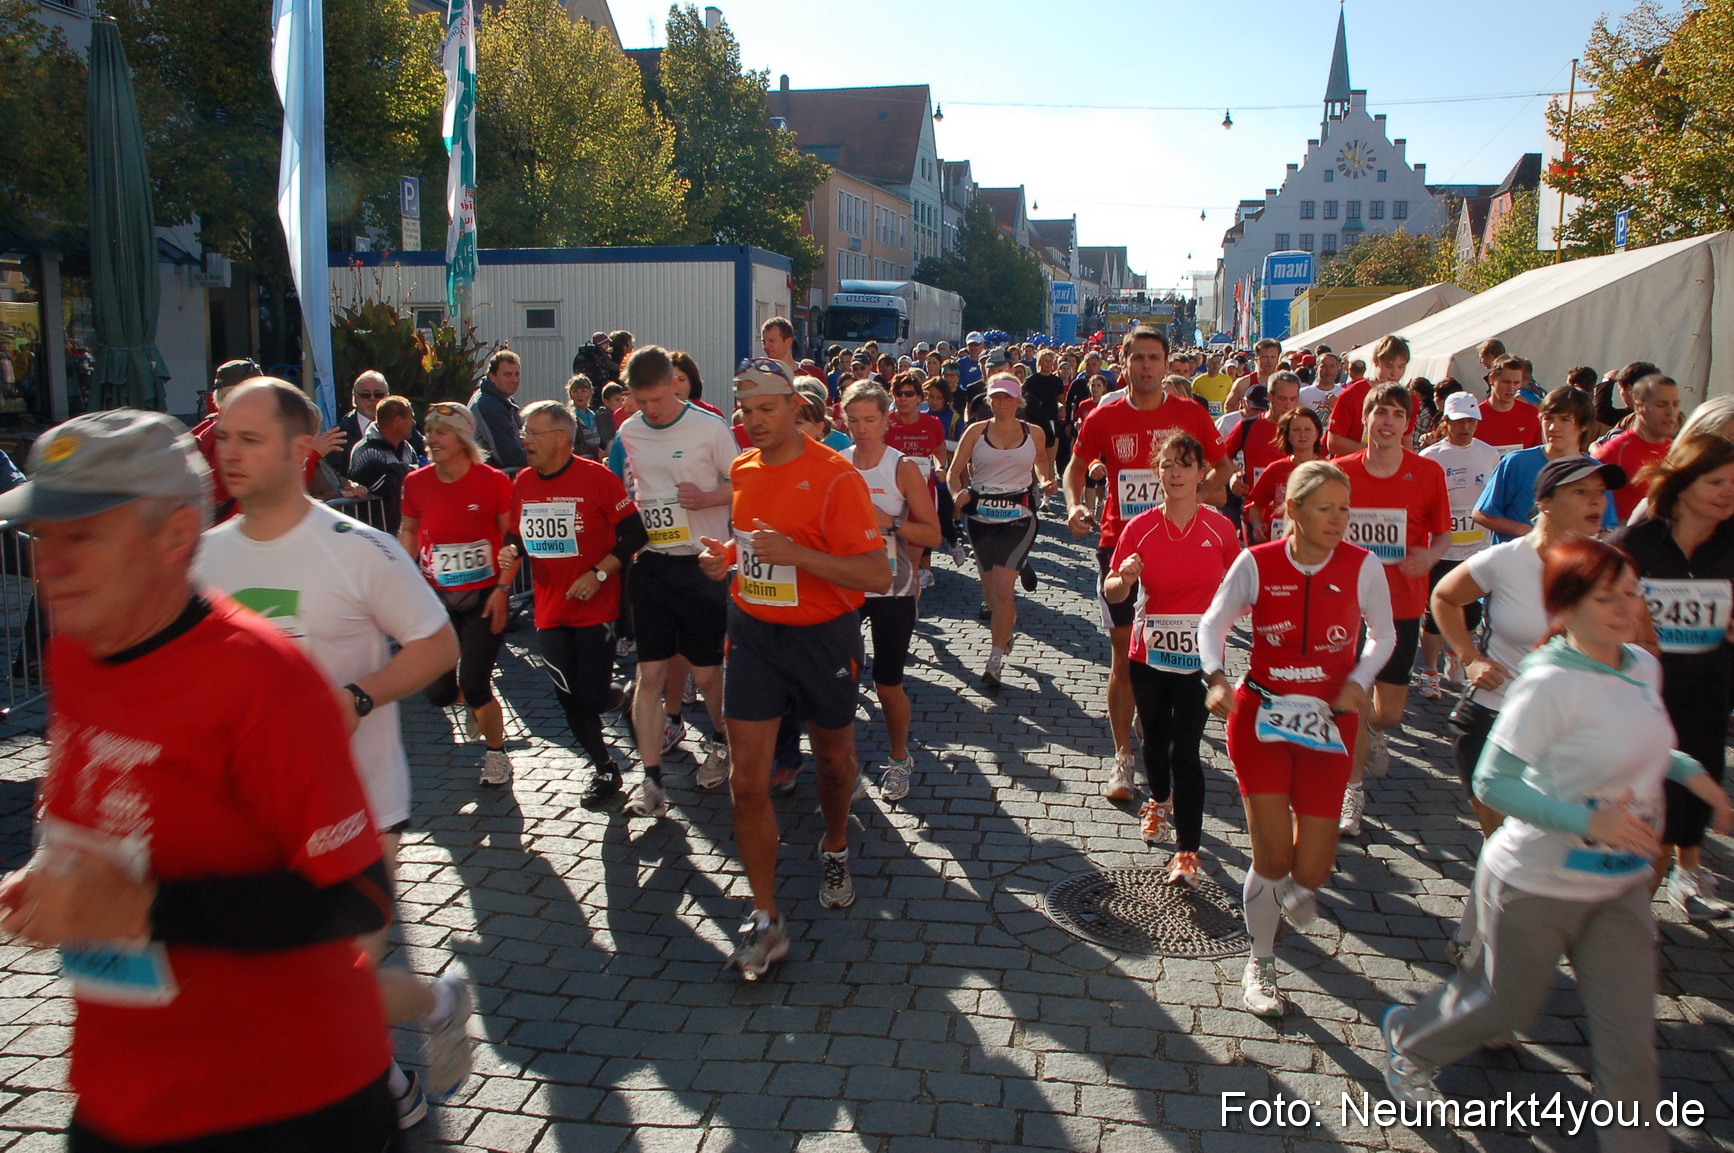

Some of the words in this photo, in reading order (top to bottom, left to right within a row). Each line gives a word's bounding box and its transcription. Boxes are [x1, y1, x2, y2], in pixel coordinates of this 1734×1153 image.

[404, 181, 415, 211] P
[1617, 216, 1625, 242] P
[1273, 260, 1309, 279] maxi
[1053, 288, 1072, 300] axi
[1059, 305, 1069, 313] dsl
[1126, 482, 1165, 502] 247
[643, 507, 674, 529] 833
[986, 509, 1012, 518] Sabine
[526, 518, 568, 539] 3305
[1349, 523, 1399, 543] 3080
[1451, 516, 1476, 532] 917
[649, 530, 681, 542] ndreas
[531, 540, 565, 553] Ludwig
[440, 549, 486, 572] 2166
[742, 550, 774, 581] 887
[744, 578, 777, 597] Achim
[1646, 600, 1718, 626] 2431
[1160, 651, 1201, 667] Marion
